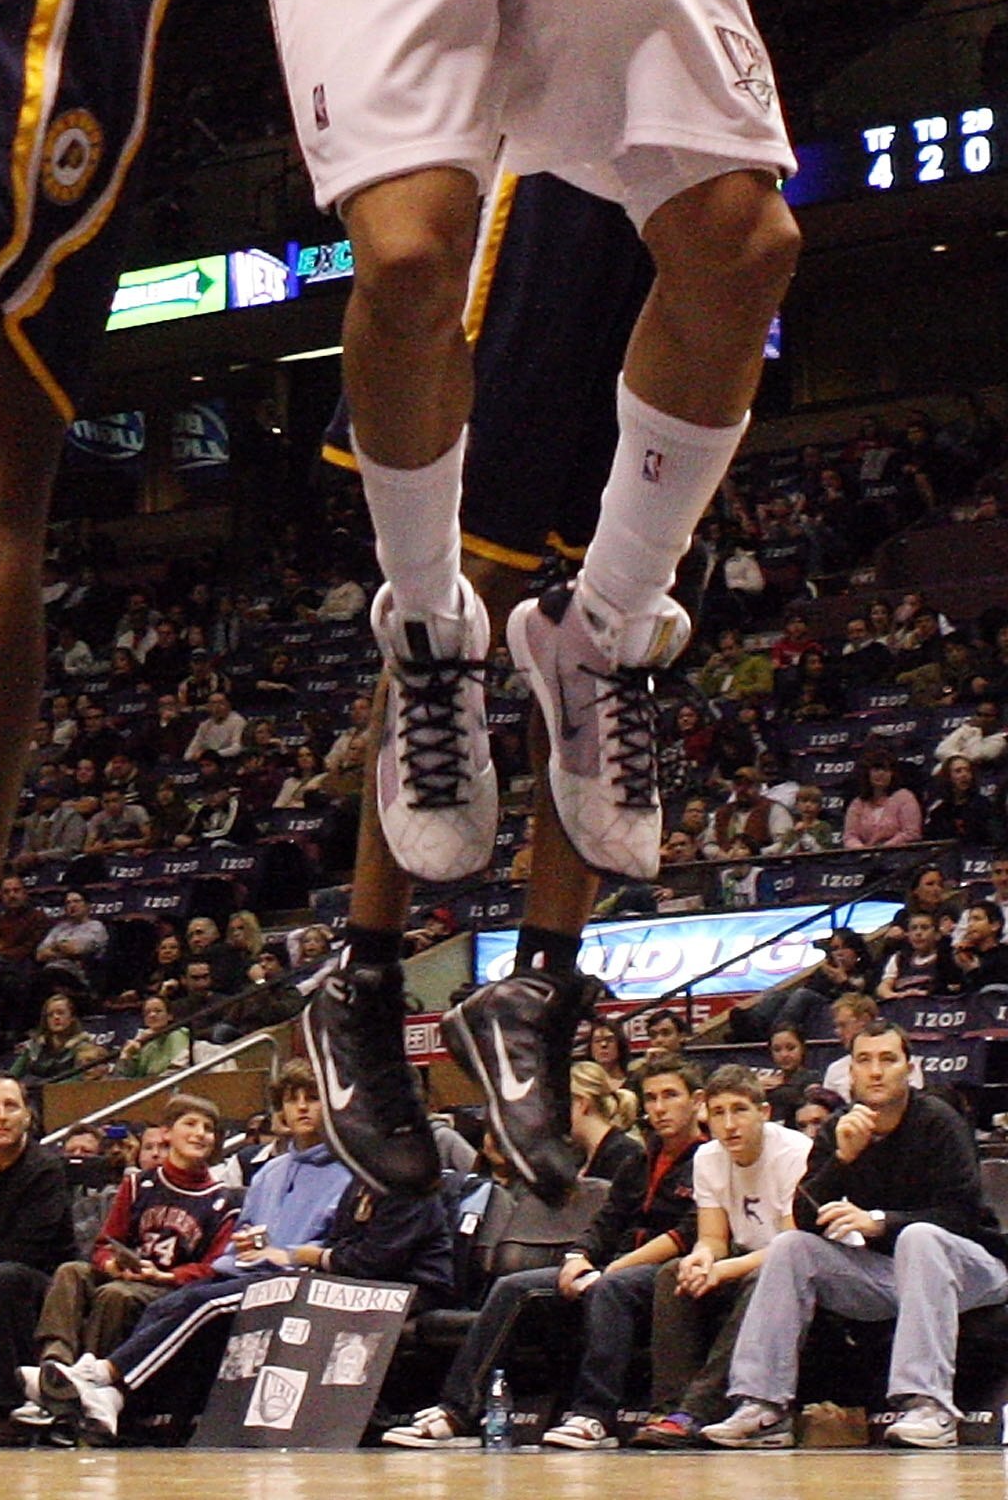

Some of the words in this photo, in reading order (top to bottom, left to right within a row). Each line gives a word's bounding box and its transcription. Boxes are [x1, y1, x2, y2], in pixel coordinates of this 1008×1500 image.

[864, 126, 896, 152] TF
[868, 153, 894, 188] 4
[918, 144, 945, 181] 2
[964, 136, 991, 172] 0
[820, 873, 866, 888] IZOD
[914, 1011, 967, 1027] IZOD
[312, 1282, 404, 1310] HARRIS
